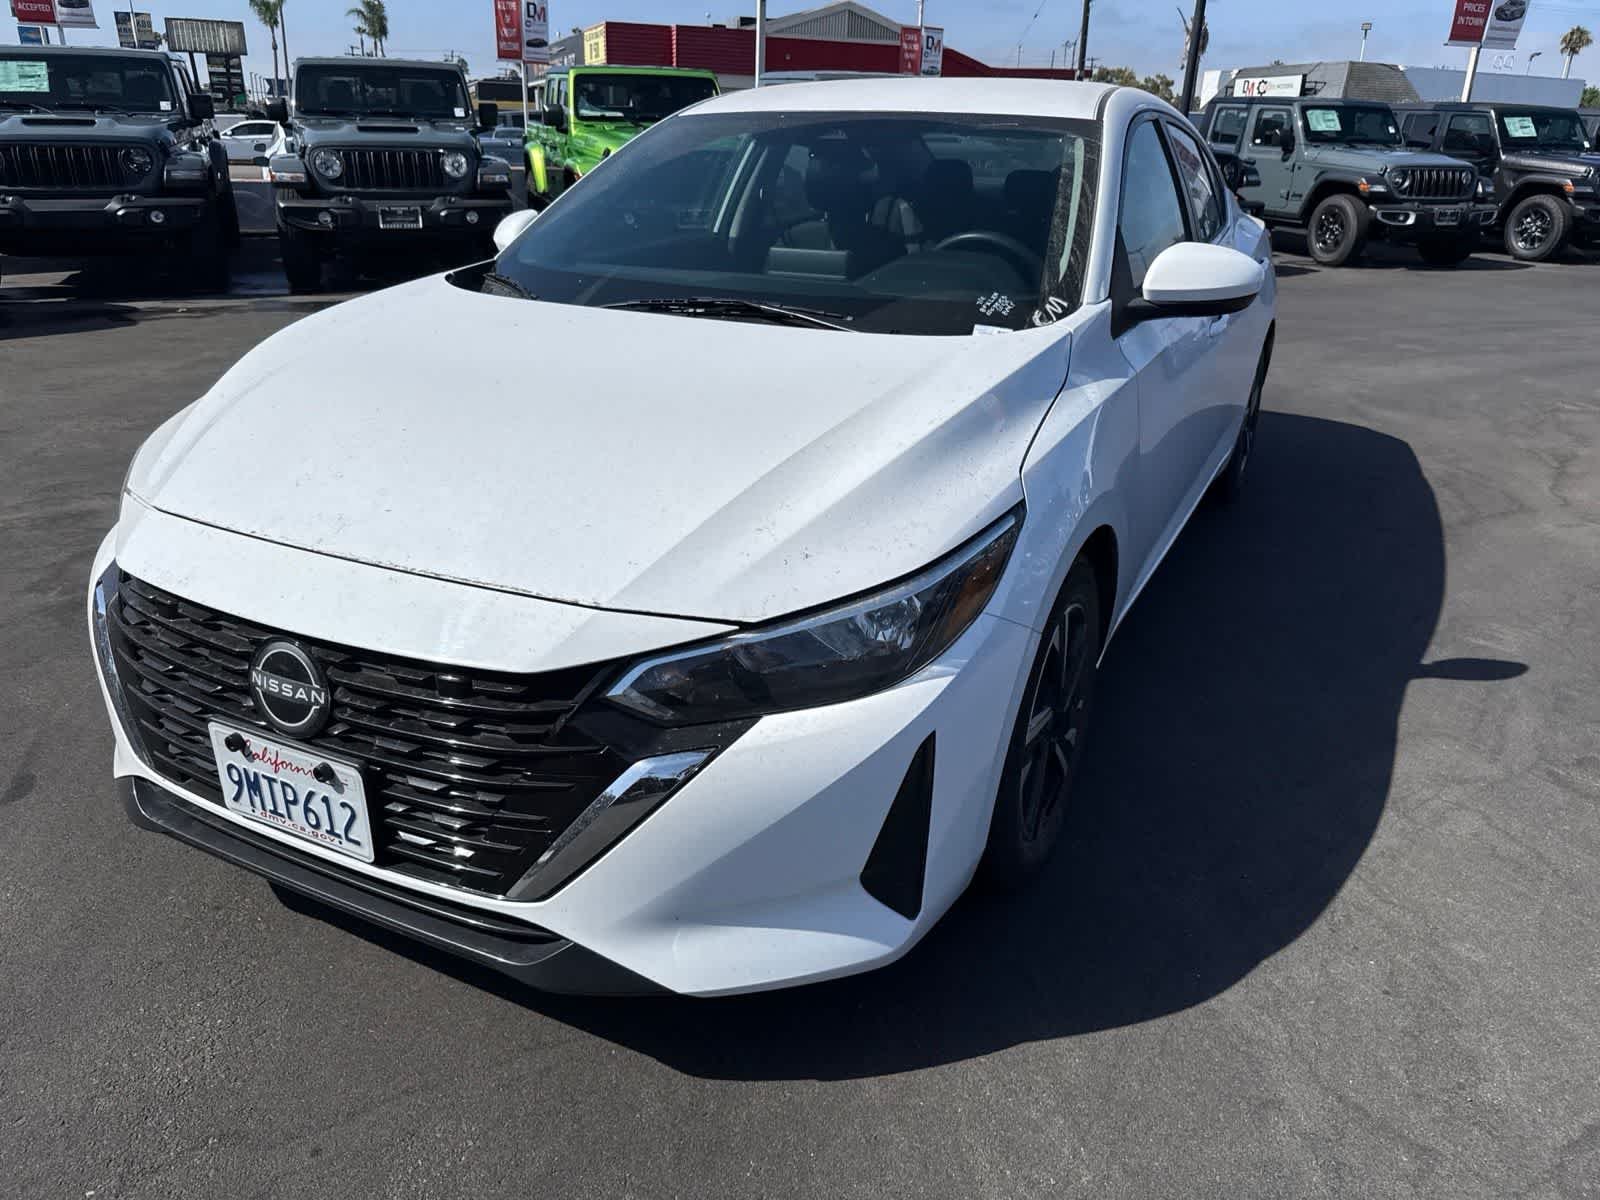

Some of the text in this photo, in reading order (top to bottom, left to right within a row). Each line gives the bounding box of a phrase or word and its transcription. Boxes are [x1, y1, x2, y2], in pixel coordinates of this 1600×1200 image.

[17, 2, 51, 12] ACCEPTED
[1463, 2, 1486, 13] PRICES
[1457, 16, 1486, 27] IN TOWN
[251, 670, 326, 705] NISSAN
[226, 763, 361, 847] 9MIP612
[259, 810, 338, 844] dmv.ca.gov
